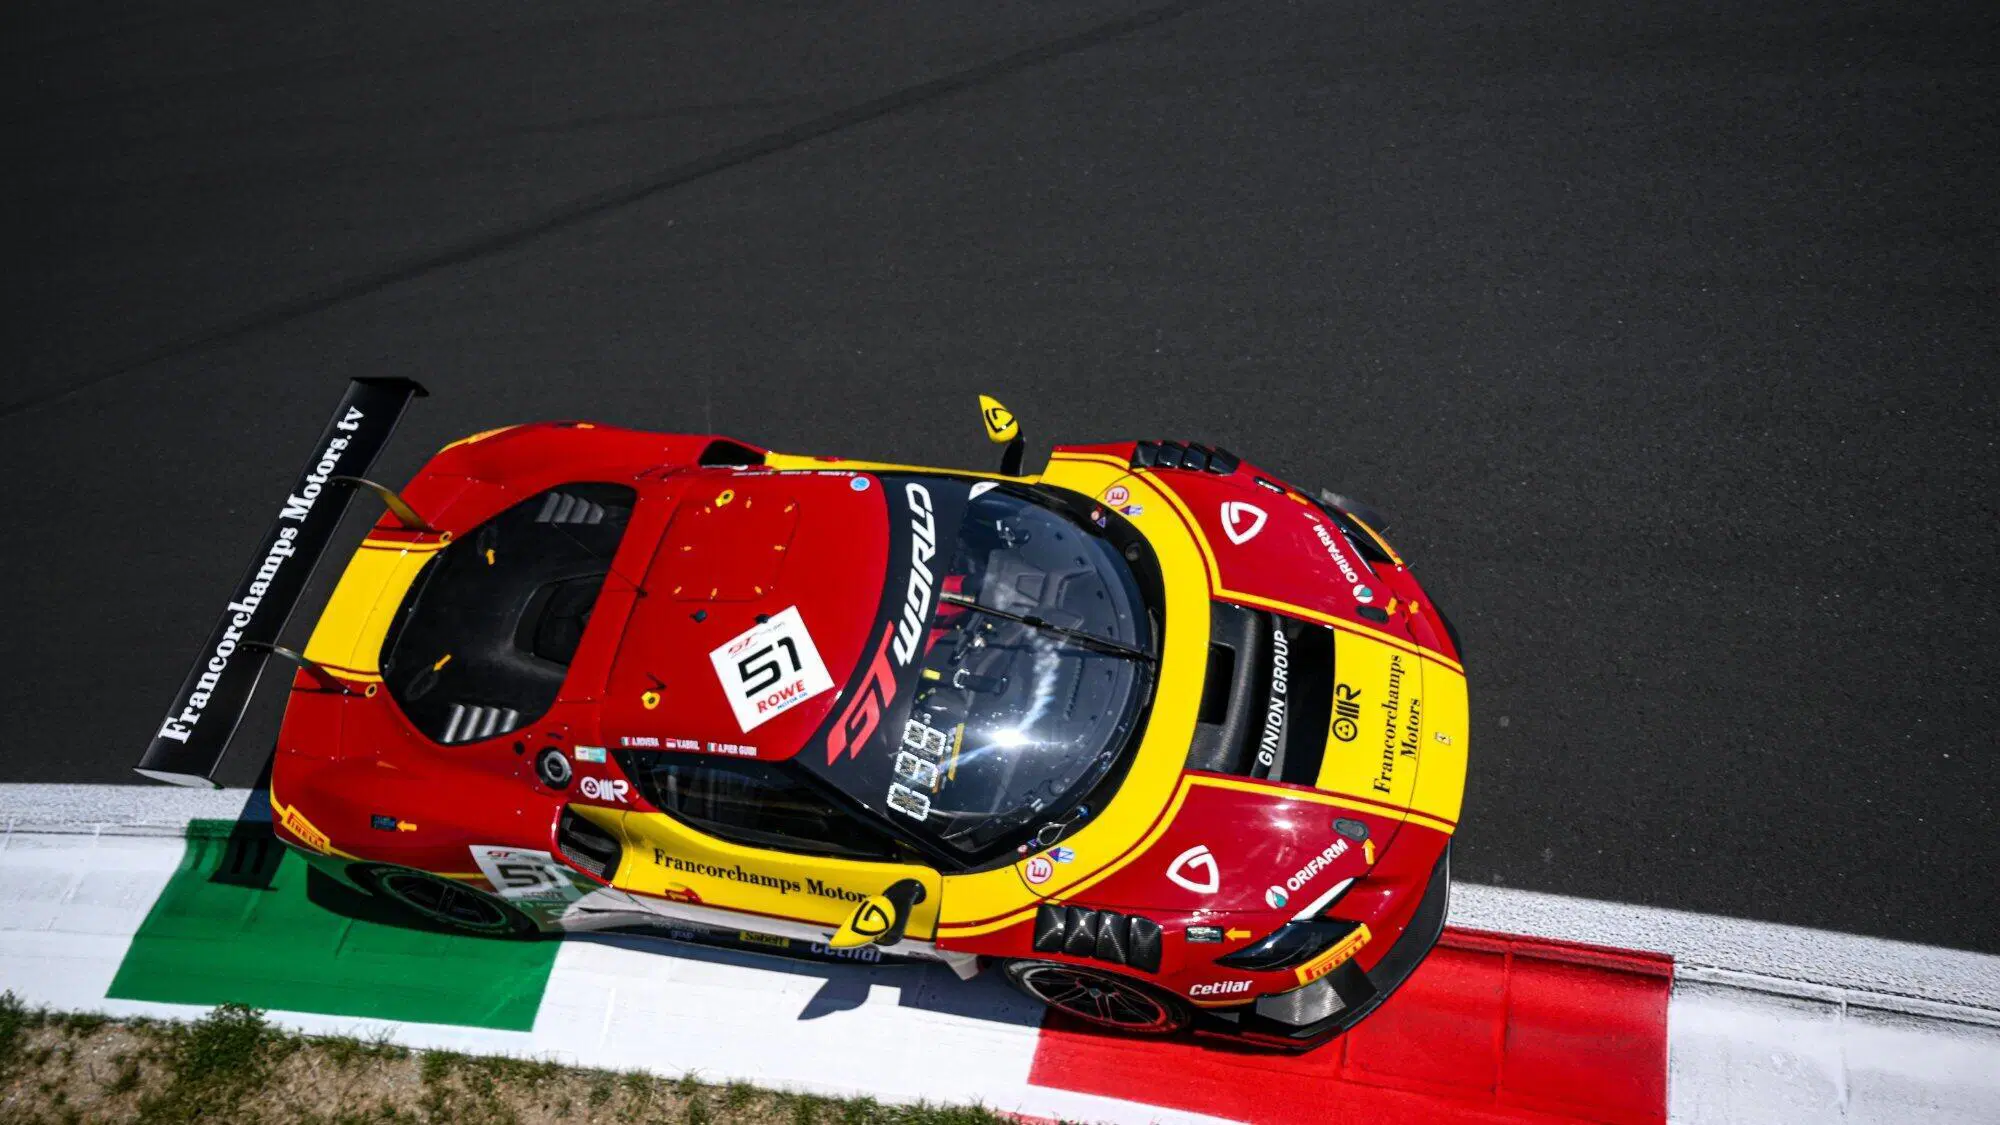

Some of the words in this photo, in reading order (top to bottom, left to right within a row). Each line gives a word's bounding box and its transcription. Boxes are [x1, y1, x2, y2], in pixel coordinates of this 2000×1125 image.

[158, 525, 299, 743] Francorchamps
[279, 405, 366, 523] Motors.tv
[1313, 523, 1358, 583] ORIFARM
[826, 620, 898, 767] GT
[892, 482, 936, 666] WORLD
[738, 636, 802, 698] 51
[1272, 630, 1289, 696] GROUP
[757, 679, 806, 713] ROWE
[1373, 653, 1406, 794] Francorchamps
[1259, 693, 1287, 767] GINION
[1399, 697, 1421, 761] Motors
[496, 864, 558, 888] 51
[653, 847, 802, 895] Francorchamps
[805, 876, 871, 903] Motor
[1286, 838, 1349, 892] ORIFARM
[1189, 980, 1254, 996] Cetilar
